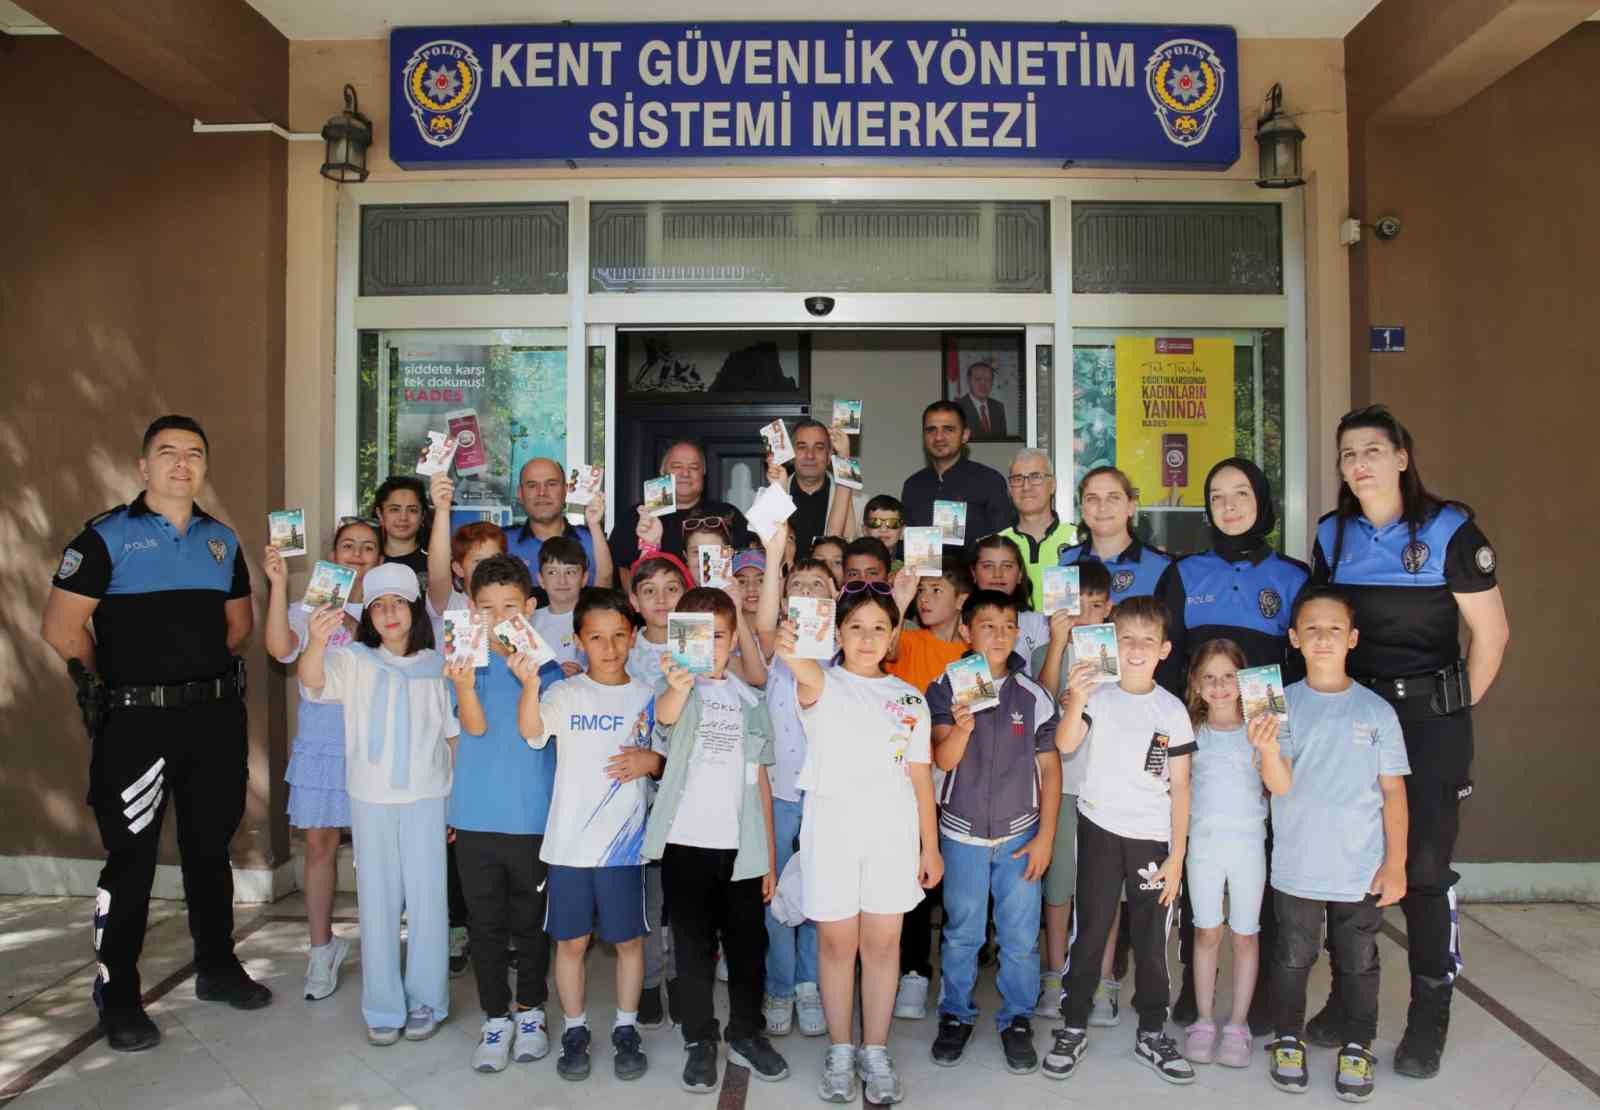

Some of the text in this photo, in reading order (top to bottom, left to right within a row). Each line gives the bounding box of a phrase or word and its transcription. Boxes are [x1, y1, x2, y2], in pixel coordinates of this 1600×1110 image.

[422, 45, 463, 60] POLİS
[492, 29, 1135, 87] KENT GÜVENLİK YÖNETİM
[588, 91, 1037, 149] SİSTEMİ MERKEZİ
[1383, 329, 1391, 350] 1
[404, 377, 425, 388] tek
[1142, 384, 1207, 400] KADINLARIN
[1142, 399, 1207, 419] YANINDA
[569, 714, 625, 732] RMCF
